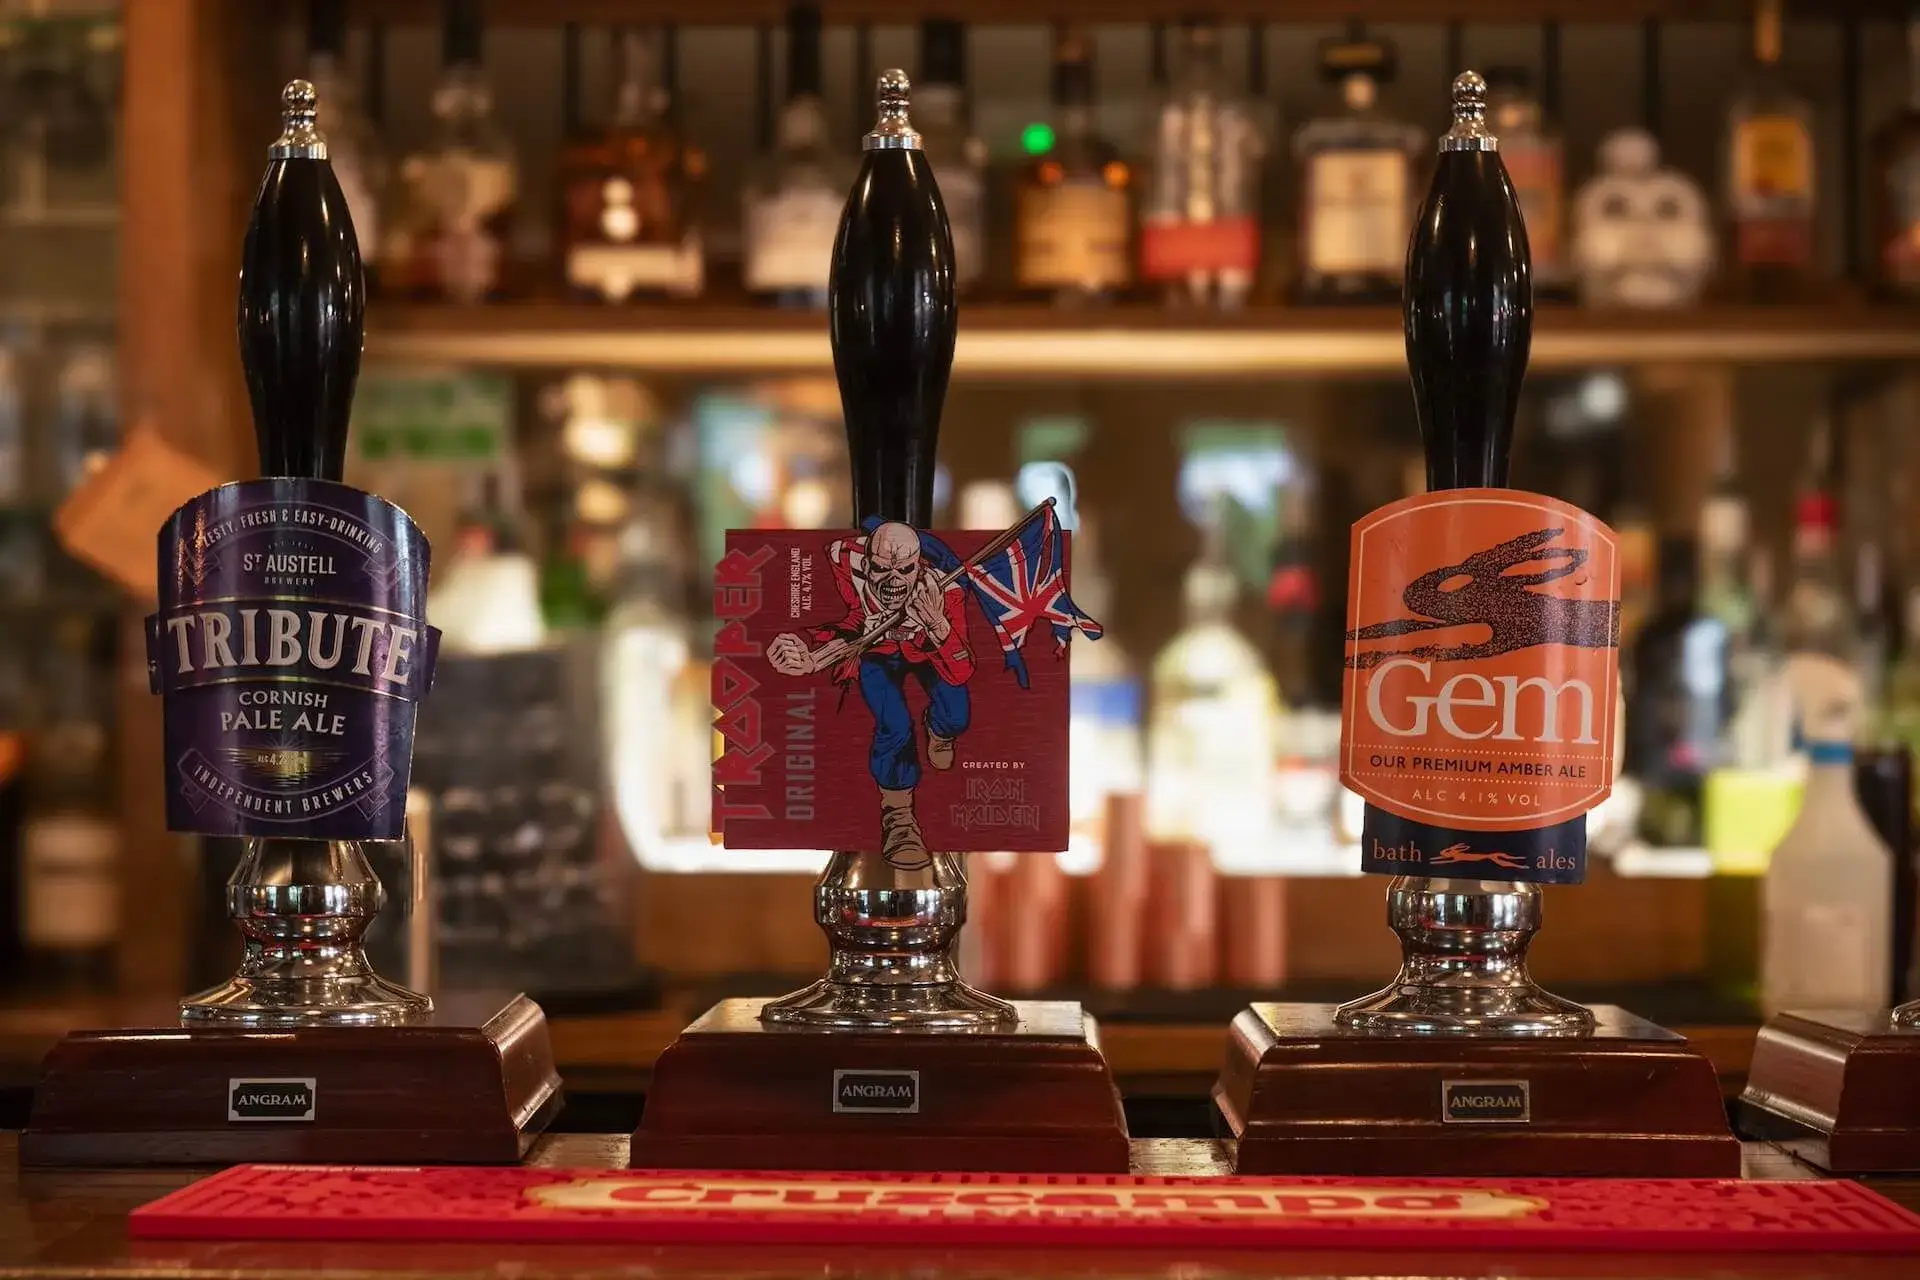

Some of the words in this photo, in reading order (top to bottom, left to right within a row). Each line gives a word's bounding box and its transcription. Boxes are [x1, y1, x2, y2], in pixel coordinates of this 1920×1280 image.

[241, 509, 277, 530] FRESH
[294, 508, 384, 554] EASY-DRINKING
[266, 554, 337, 575] AUSTELL
[790, 547, 801, 581] ENGLAND
[264, 576, 315, 586] BREWERY
[801, 573, 812, 593] 4.7%
[790, 582, 801, 618] CHESHIRE
[167, 608, 418, 685] TRIBUTE
[238, 690, 328, 708] CORNISH
[1366, 658, 1600, 745] Gem
[220, 709, 283, 732] PALE
[291, 711, 347, 736] ALE
[785, 687, 816, 821] ORIGINAL
[962, 761, 1009, 769] CREATED
[1012, 761, 1026, 769] BY
[1369, 754, 1406, 769] OUR
[1412, 756, 1492, 774] PREMIUM
[1496, 760, 1554, 777] AMBER
[1558, 764, 1587, 778] ALE
[193, 765, 293, 814] INDEPENDENT
[302, 771, 374, 812] BREWERS
[966, 778, 1024, 803] IRON
[1412, 789, 1448, 802] ALC
[1507, 793, 1542, 807] VOL
[949, 804, 1040, 831] MAIDEN
[1373, 839, 1423, 864] bath
[1536, 848, 1577, 870] ales
[238, 1094, 307, 1106] ANGRAM
[842, 1084, 912, 1097] ANGRAM
[1450, 1095, 1522, 1108] ANGRAM
